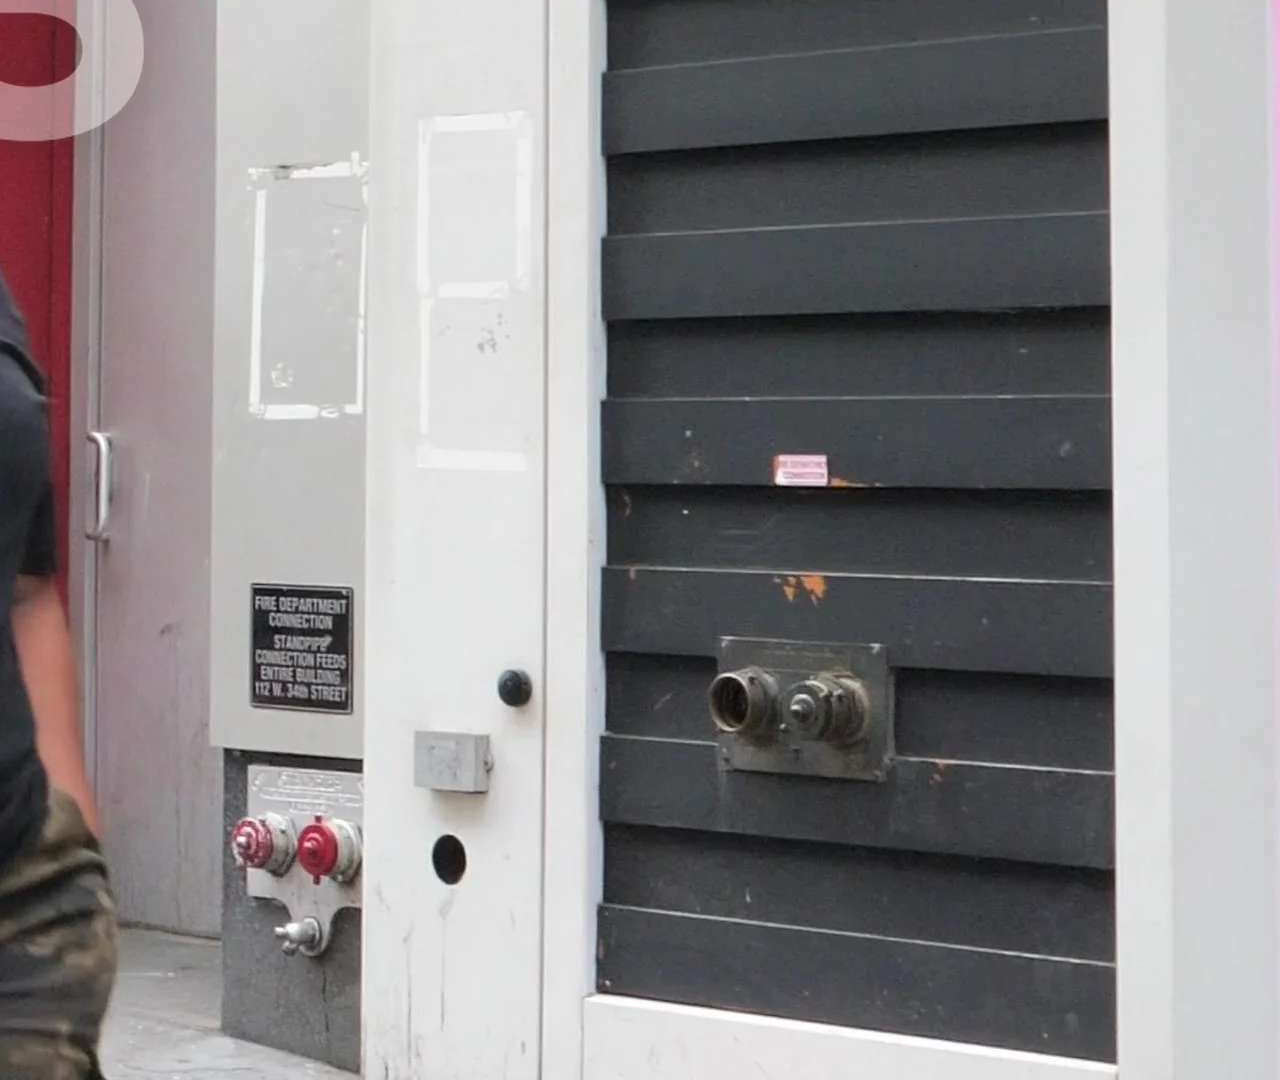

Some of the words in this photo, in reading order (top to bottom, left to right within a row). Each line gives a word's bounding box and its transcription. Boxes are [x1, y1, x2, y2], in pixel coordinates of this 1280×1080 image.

[255, 596, 277, 611] FIRE
[279, 597, 347, 614] DEPARTMENT
[269, 612, 333, 629] CONNECTION
[255, 649, 315, 667] CONNECTION
[316, 653, 347, 669] FEEDS
[260, 665, 294, 681] ENTIRE
[295, 668, 341, 685] BUILDING
[255, 681, 270, 696] 112
[310, 685, 347, 701] STREET
